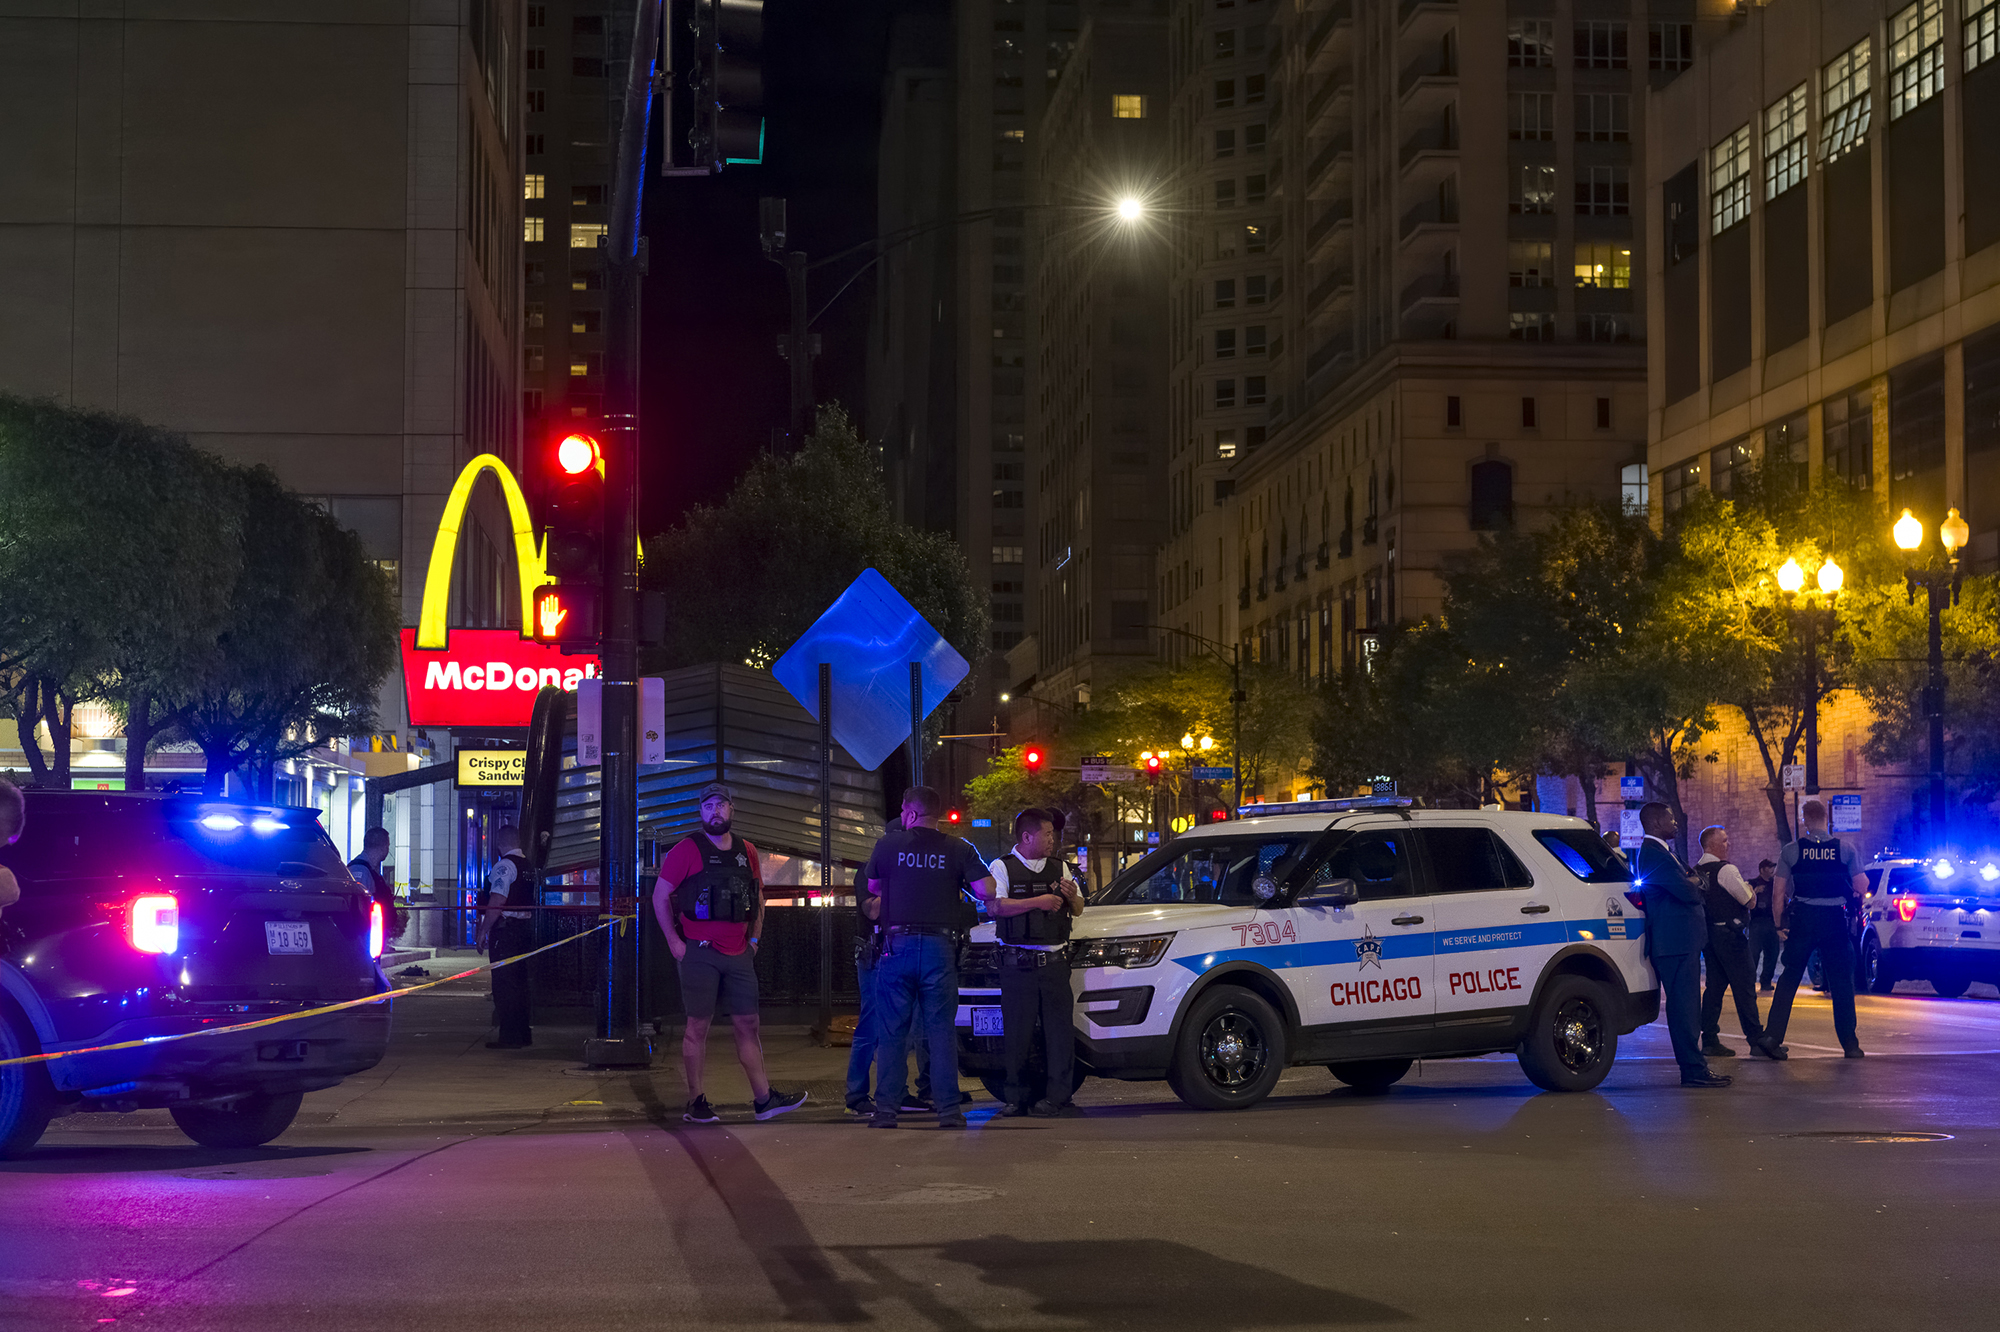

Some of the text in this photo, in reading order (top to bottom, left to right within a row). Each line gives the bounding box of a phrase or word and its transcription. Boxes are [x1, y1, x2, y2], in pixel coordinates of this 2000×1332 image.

[469, 758, 510, 770] Crispy
[897, 851, 946, 869] POLICE
[1802, 848, 1836, 860] POLICE
[278, 931, 308, 947] 18 459
[1232, 920, 1296, 947] 7304
[1443, 932, 1522, 946] WE SERVE AND PROTECT
[1357, 943, 1380, 954] CAPS
[1330, 967, 1522, 1006] CHICAGO POLICE
[981, 1016, 988, 1030] 15
